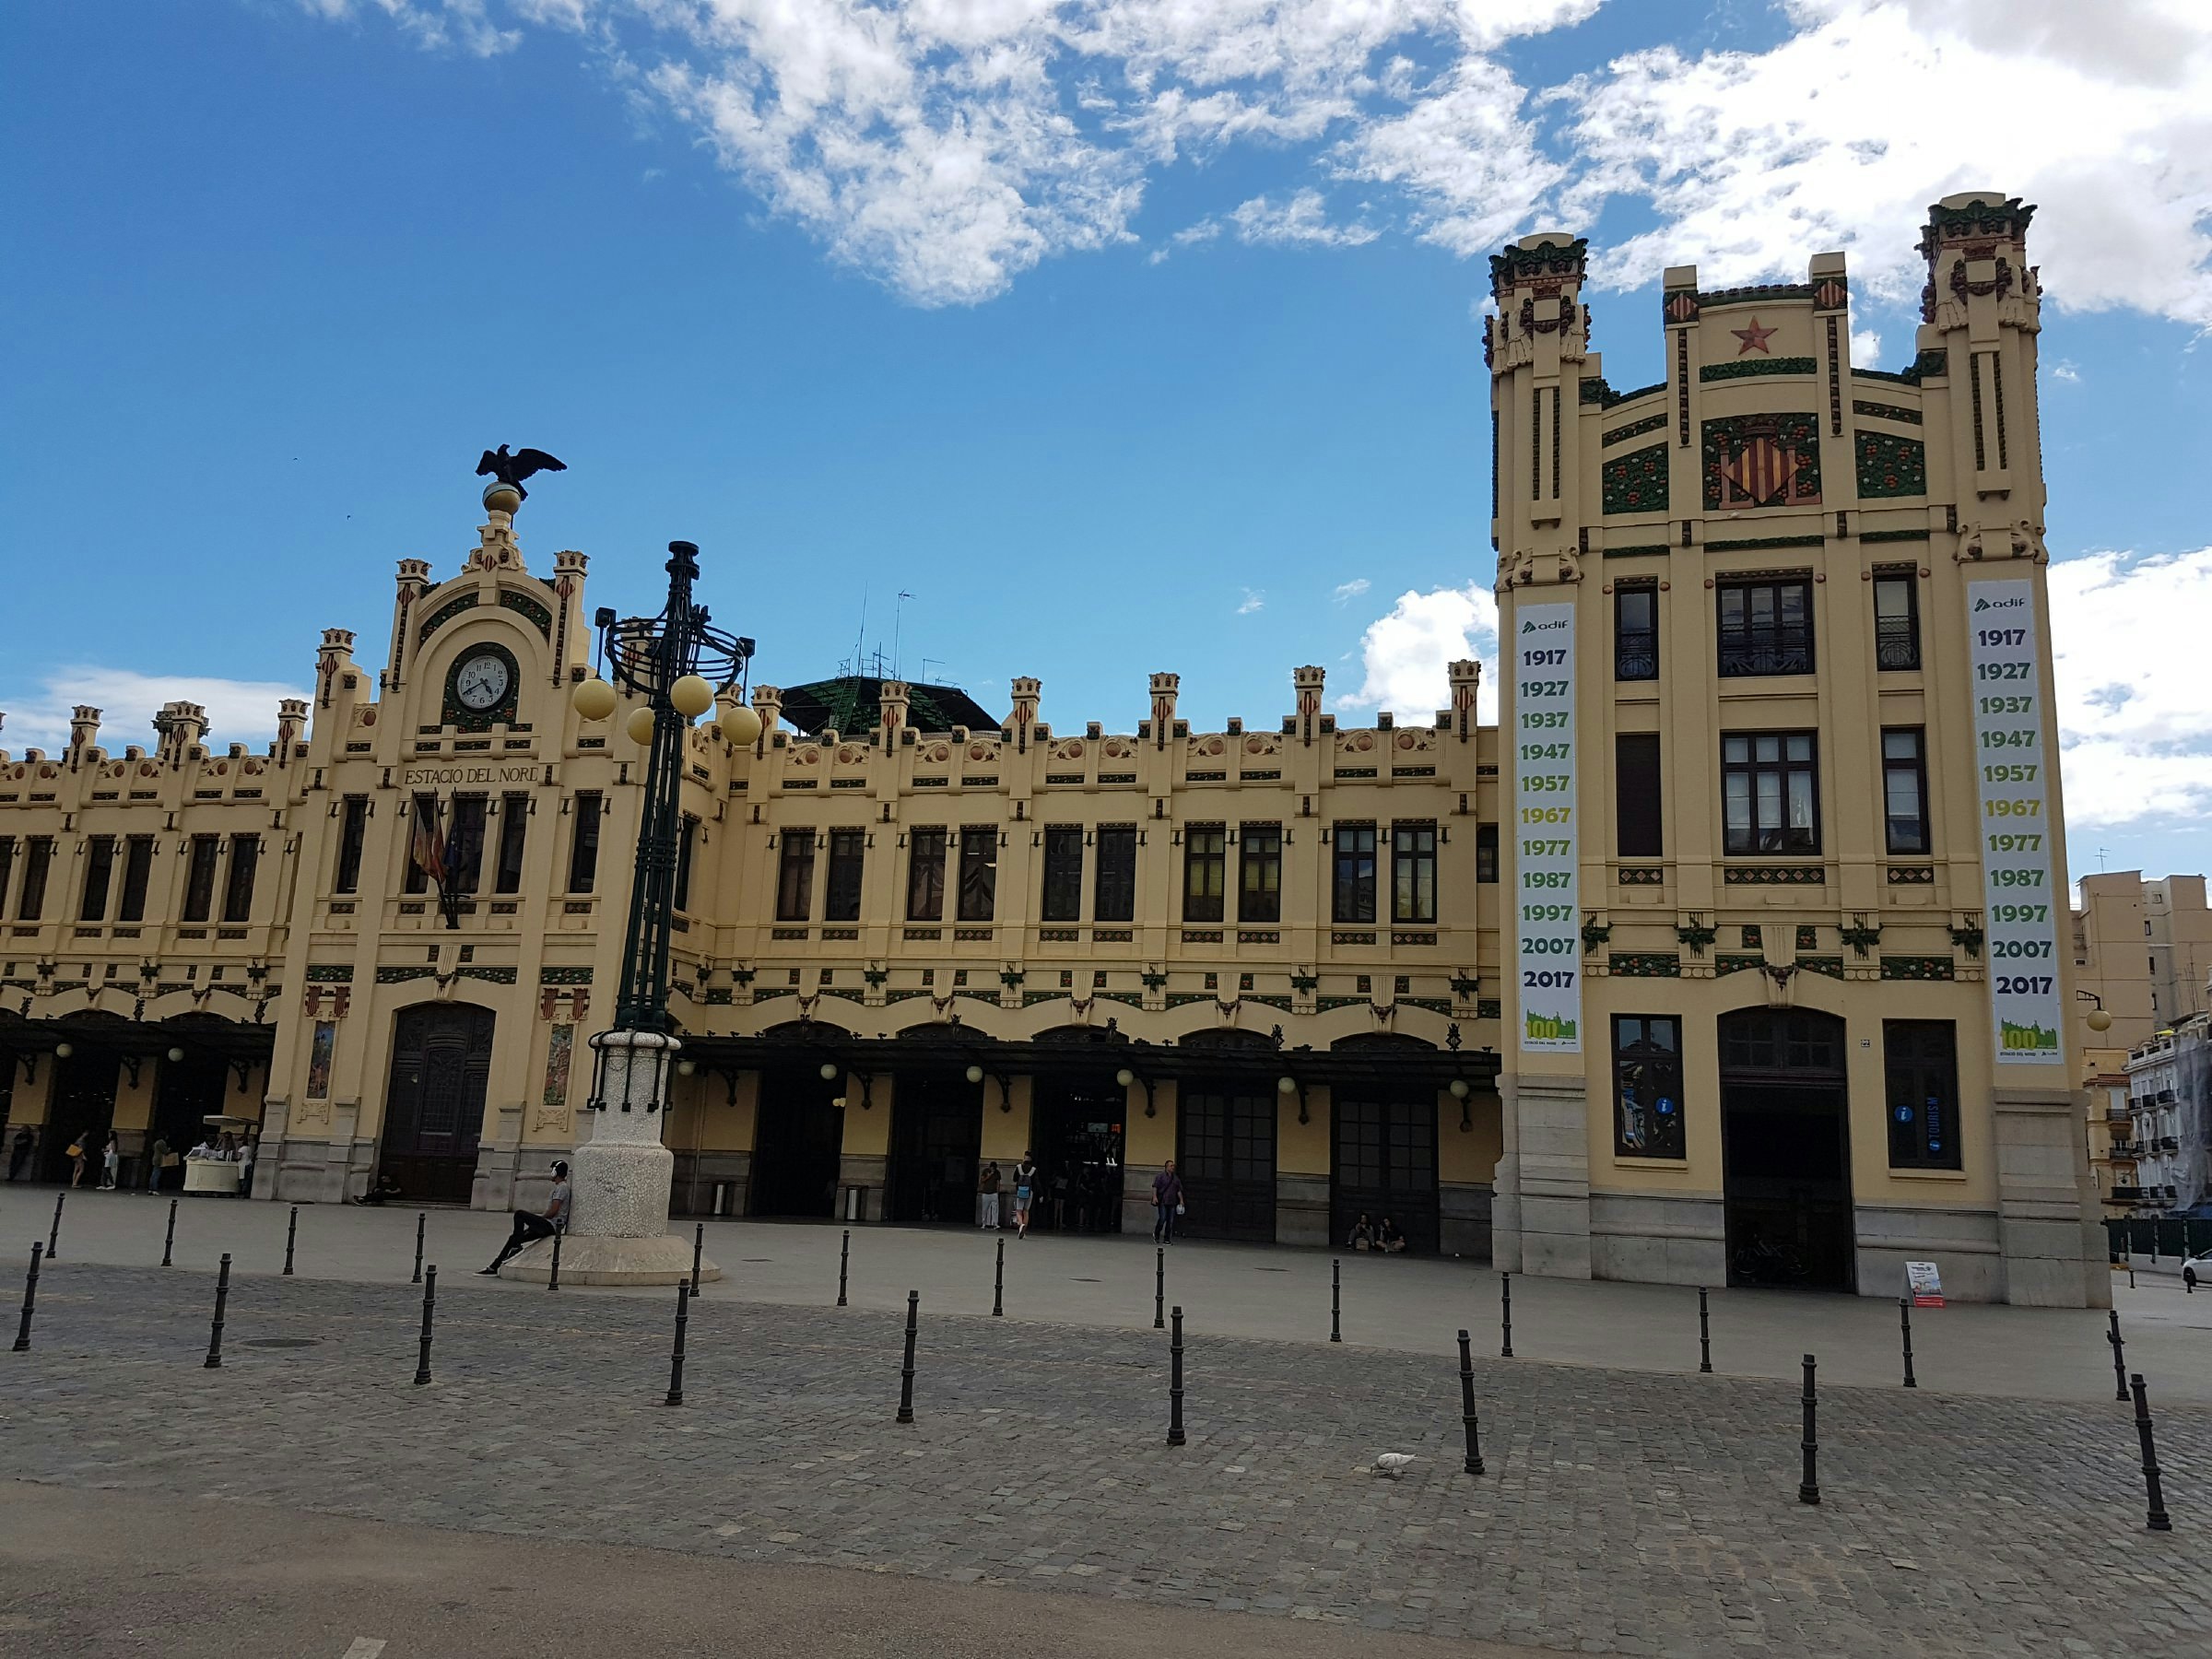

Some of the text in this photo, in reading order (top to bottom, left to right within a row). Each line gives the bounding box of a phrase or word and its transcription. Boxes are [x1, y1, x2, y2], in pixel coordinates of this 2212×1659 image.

[1992, 597, 2025, 608] adif
[1537, 619, 1569, 630] adif
[1978, 629, 2027, 646] 1917
[1523, 650, 1567, 665] 1917
[468, 671, 477, 679] 10
[1977, 663, 2031, 679] 1927
[1521, 681, 1570, 697] 1927
[1980, 697, 2033, 713] 1937
[1521, 712, 1570, 728] 1937
[1981, 731, 2036, 747] 1947
[1521, 744, 1571, 759] 1947
[405, 765, 464, 784] ESTACIÓ
[466, 768, 496, 782] DEL
[1983, 765, 2038, 782] 1957
[1521, 775, 1571, 792] 1957
[1521, 807, 1571, 823] 1967
[1985, 800, 2041, 817] 1967
[1523, 841, 1571, 855] 1977
[1988, 835, 2042, 852] 1977
[1523, 873, 1571, 888] 1987
[1990, 870, 2044, 887] 1987
[1522, 905, 1573, 921] 1997
[1991, 905, 2048, 922] 1997
[1522, 938, 1575, 954] 2007
[1992, 941, 2053, 958] 2007
[1523, 971, 1575, 988] 2017
[1995, 977, 2053, 994] 2017
[1524, 1020, 1558, 1040] 100
[1999, 1030, 2037, 1051] 100
[1926, 1097, 1940, 1140] TOURISM
